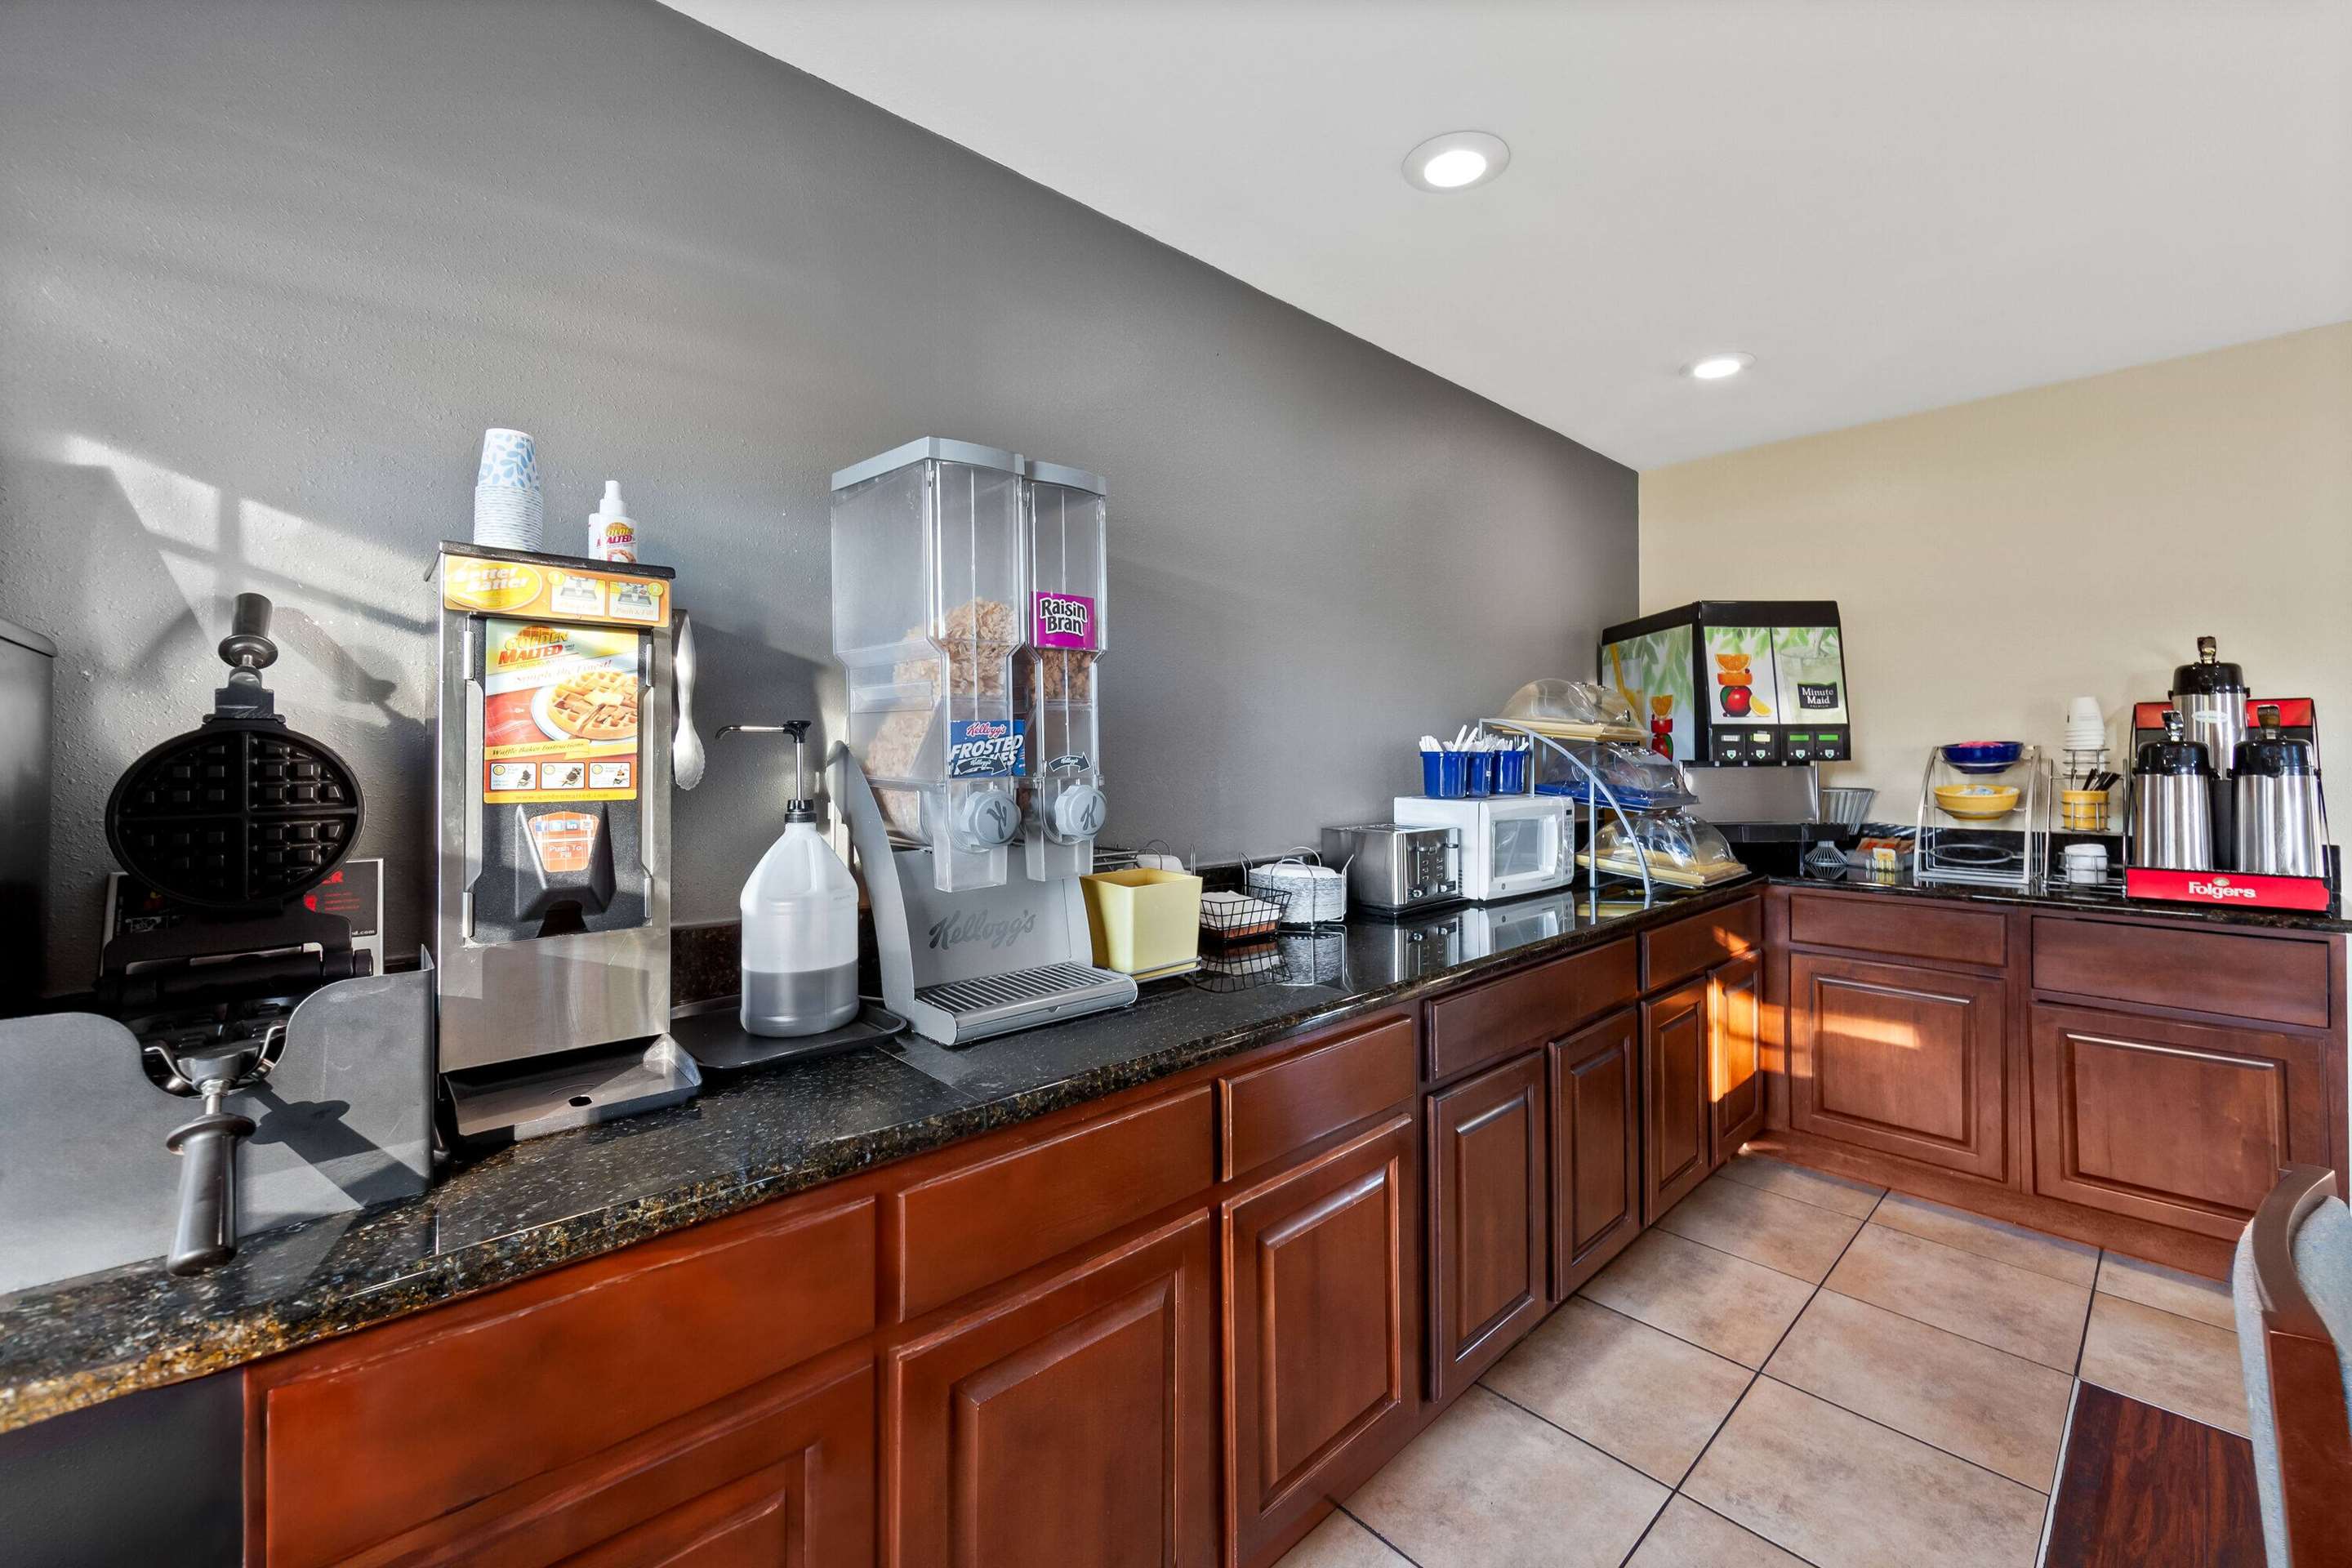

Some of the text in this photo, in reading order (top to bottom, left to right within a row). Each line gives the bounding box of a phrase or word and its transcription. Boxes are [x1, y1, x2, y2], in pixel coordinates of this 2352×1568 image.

[1040, 598, 1088, 622] Raisin
[1046, 616, 1084, 636] Bran
[504, 630, 568, 651] GOLDEN
[498, 644, 564, 665] MALTED
[1802, 687, 1833, 696] Minute
[1807, 696, 1830, 705] Maid
[967, 722, 1007, 738] Kellogg's
[950, 734, 1023, 760] FROSTED
[2189, 881, 2257, 899] Folgers
[929, 909, 1036, 951] Kellogg's
